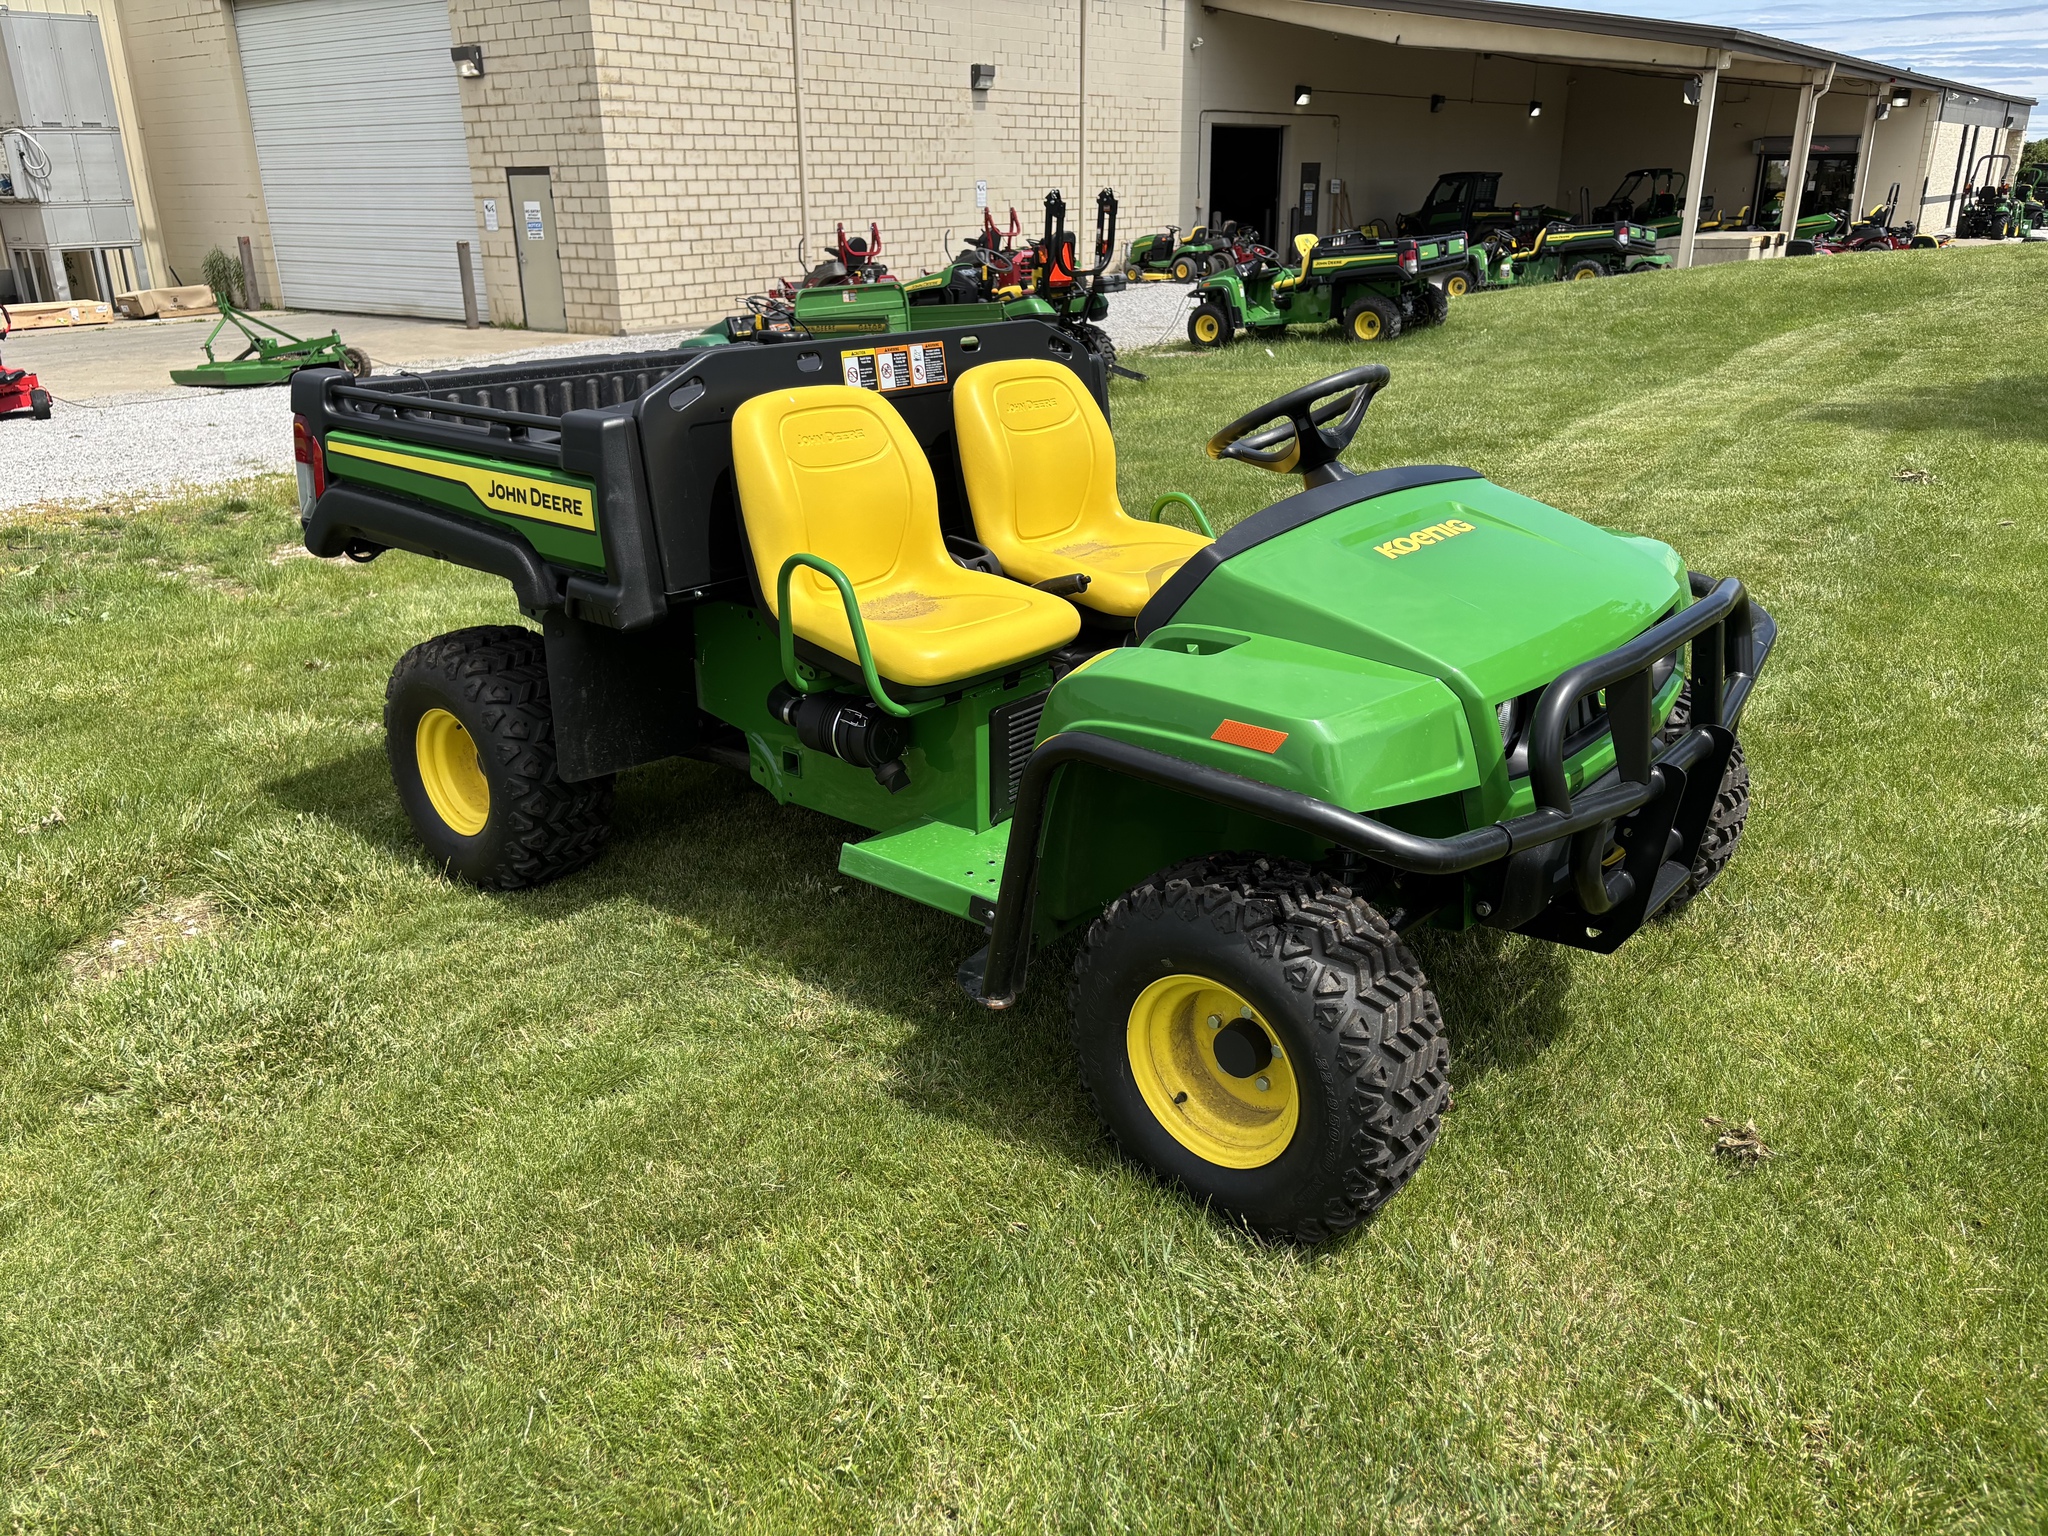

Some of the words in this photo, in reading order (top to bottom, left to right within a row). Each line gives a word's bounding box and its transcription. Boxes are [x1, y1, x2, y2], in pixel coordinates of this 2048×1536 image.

[858, 323, 884, 331] GATOR
[1006, 401, 1026, 413] JOHN
[1026, 397, 1058, 410] DEERE
[797, 433, 825, 447] JOHN
[825, 428, 866, 443] DEERE
[488, 480, 527, 505] JOHN
[530, 487, 583, 516] DEERE
